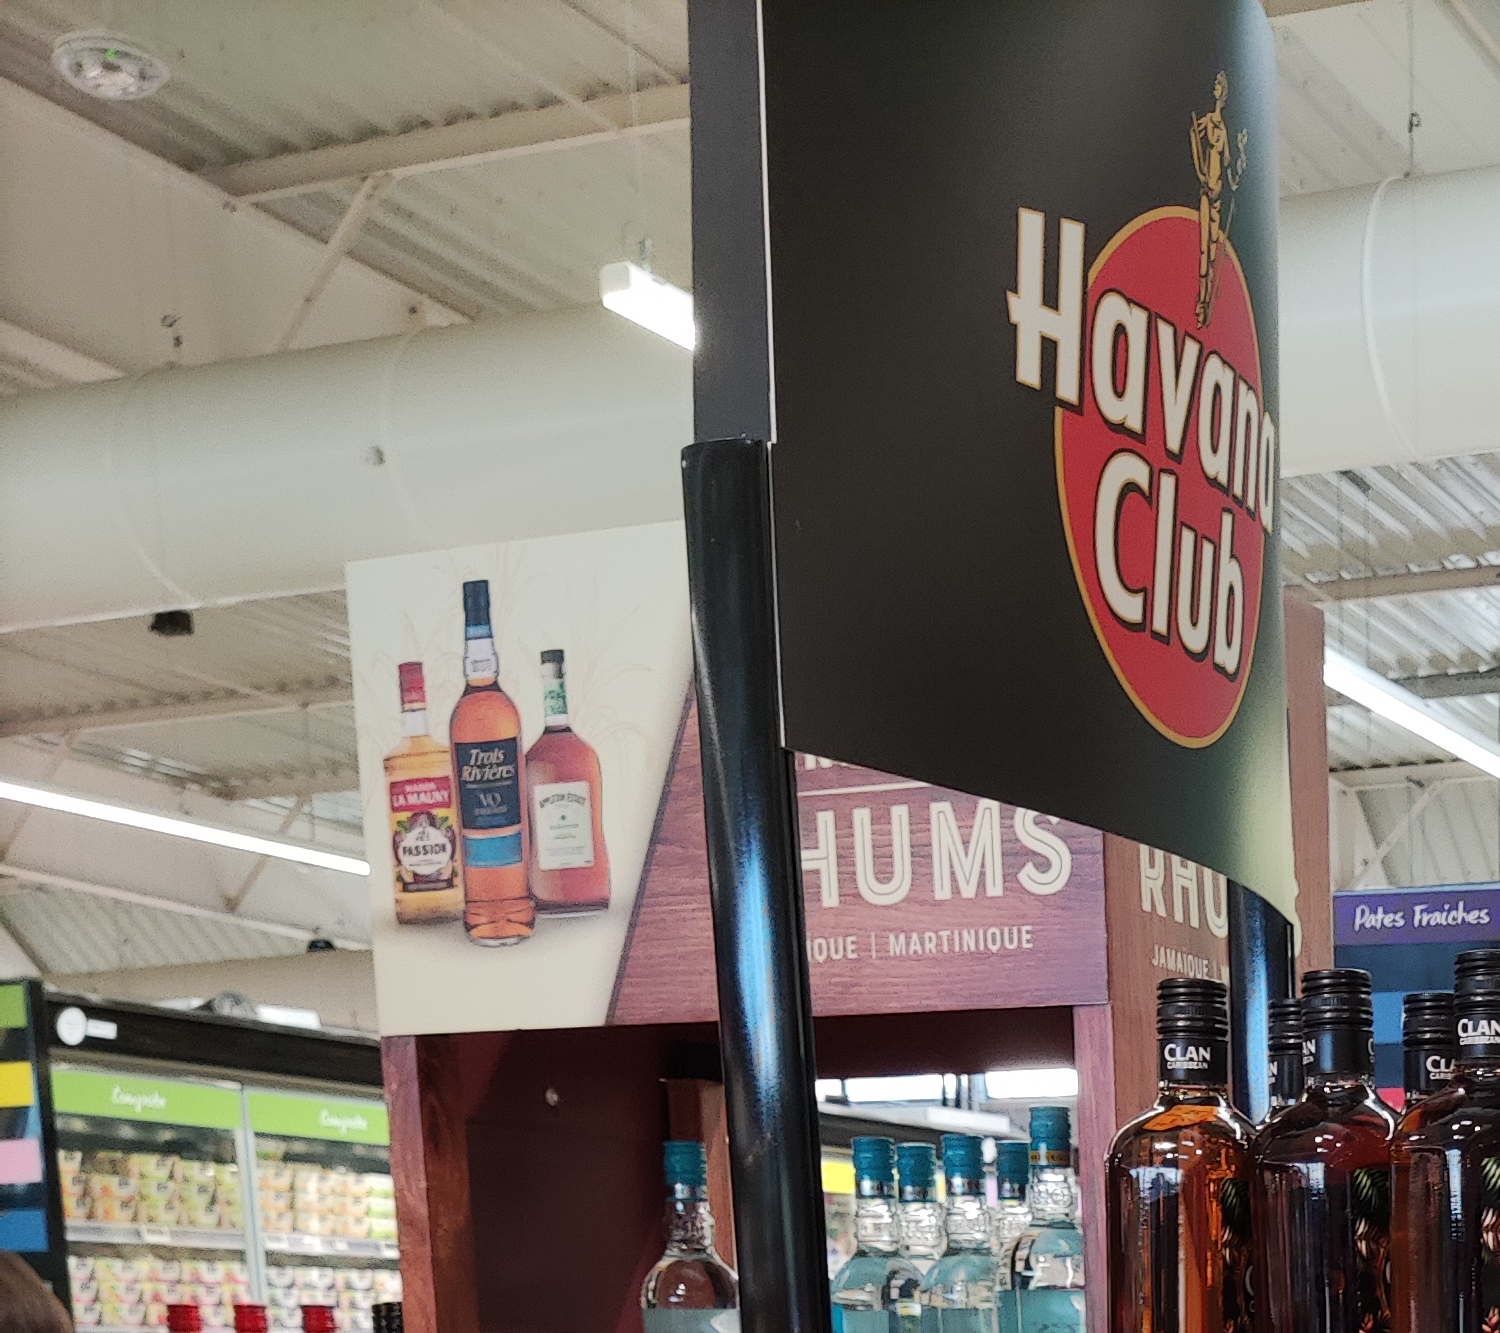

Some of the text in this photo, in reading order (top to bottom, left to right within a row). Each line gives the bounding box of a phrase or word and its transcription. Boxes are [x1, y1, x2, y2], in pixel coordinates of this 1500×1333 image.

[1007, 206, 1276, 535] Havana
[1094, 451, 1245, 675] Club
[800, 798, 1072, 908] HUMS
[1139, 843, 1229, 939] RHU
[888, 925, 1035, 957] MARTINIQUE
[1163, 1043, 1212, 1063] CLAN
[1425, 1055, 1456, 1073] CLA
